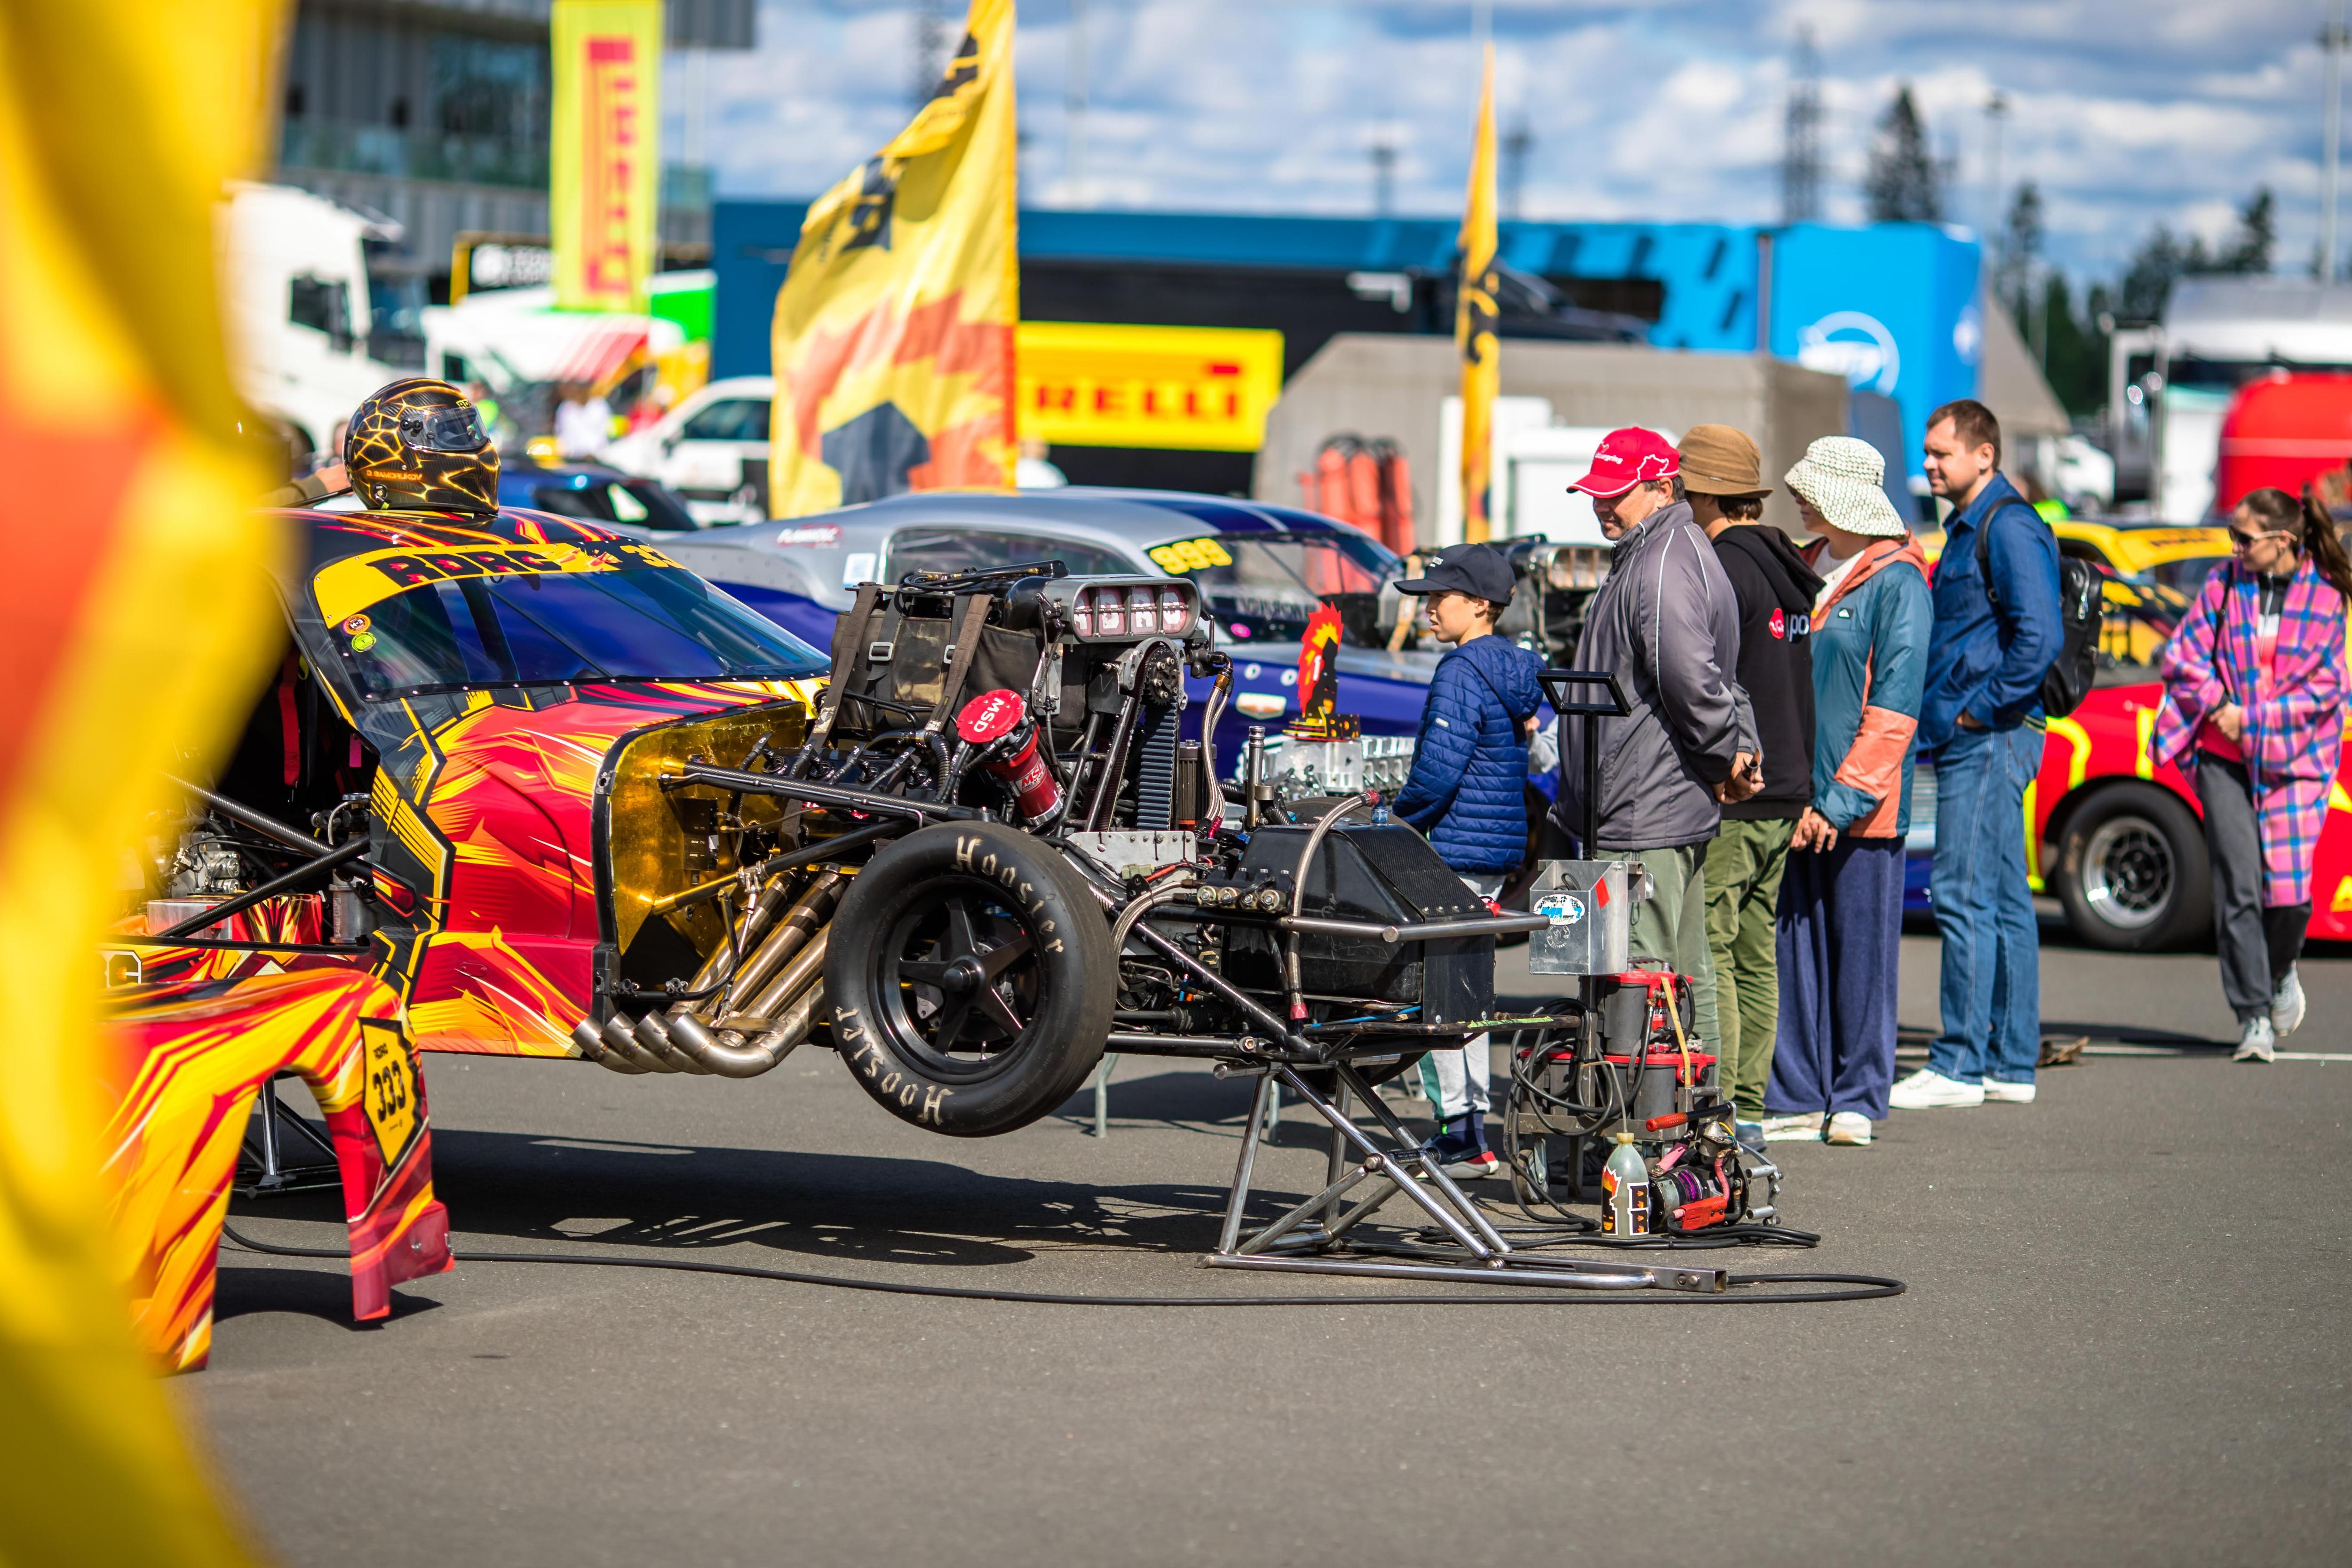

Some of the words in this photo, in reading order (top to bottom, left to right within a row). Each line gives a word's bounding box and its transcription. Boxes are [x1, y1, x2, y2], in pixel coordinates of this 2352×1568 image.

[365, 550, 562, 588] RDRC
[1150, 538, 1232, 574] 999
[973, 697, 1005, 733] MSD
[1021, 760, 1043, 788] MSD
[373, 1059, 406, 1123] 333
